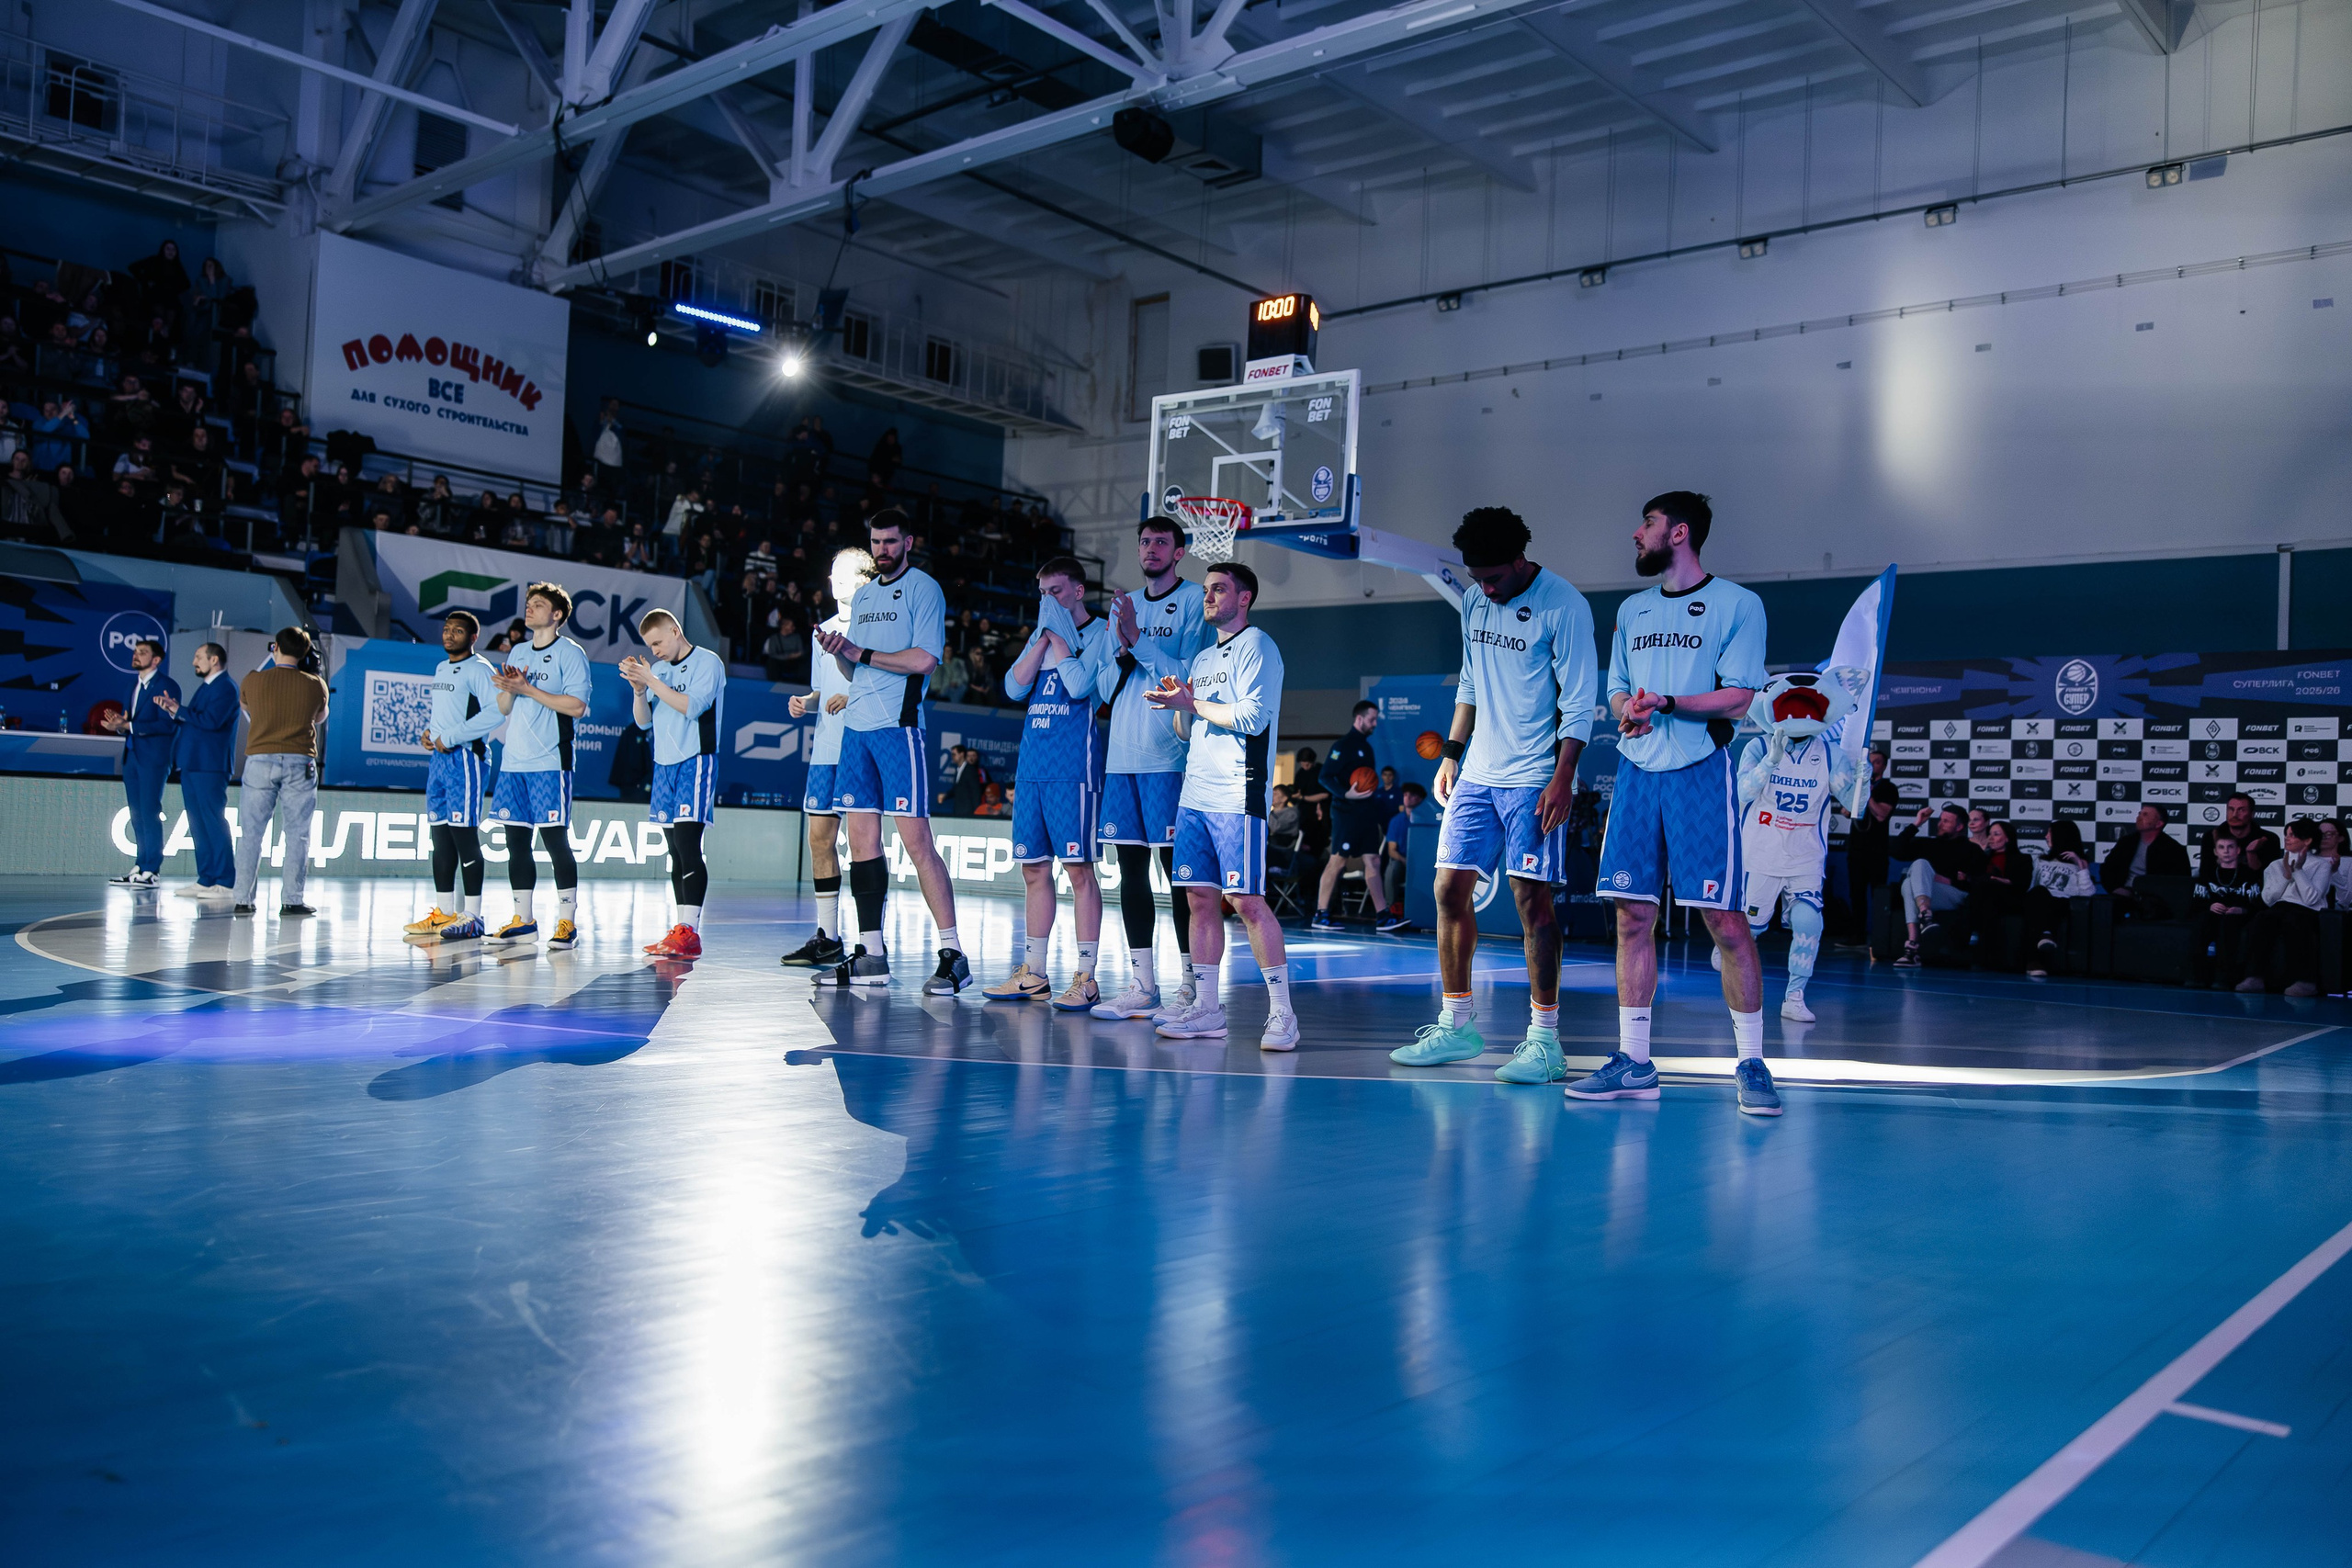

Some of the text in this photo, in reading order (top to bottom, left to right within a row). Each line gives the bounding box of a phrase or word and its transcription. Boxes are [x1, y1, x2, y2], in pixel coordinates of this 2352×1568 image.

[342, 333, 543, 412] ПОМОЩНИК
[1247, 364, 1290, 380] FONBET
[428, 378, 465, 405] ВСЕ
[1307, 397, 1332, 412] FON
[350, 389, 529, 437] ДЛЯ СУХОГО СТРОИТЕЛЬСТВА
[1307, 410, 1331, 423] BET
[1169, 415, 1191, 428] FON
[1169, 426, 1191, 440] BET
[526, 582, 650, 647] СК
[857, 612, 898, 626] ДИНАМО
[1472, 629, 1527, 652] ДИНАМО
[1632, 632, 1702, 652] ДИНАМО
[2297, 670, 2341, 680] FONBET
[2233, 679, 2294, 689] СУПЕРЛИГА
[2295, 686, 2341, 695] 2025/26
[1031, 715, 1050, 729] КРАЙ
[1976, 725, 2006, 733] FONBET
[2245, 724, 2279, 732] FONBET
[1896, 764, 1924, 773] FONBET
[1975, 764, 2005, 773] FONBET
[2059, 765, 2090, 773] FONBET
[1770, 773, 1818, 788] ДИНАМО
[1775, 790, 1809, 814] 125
[2253, 811, 2278, 819] NBET
